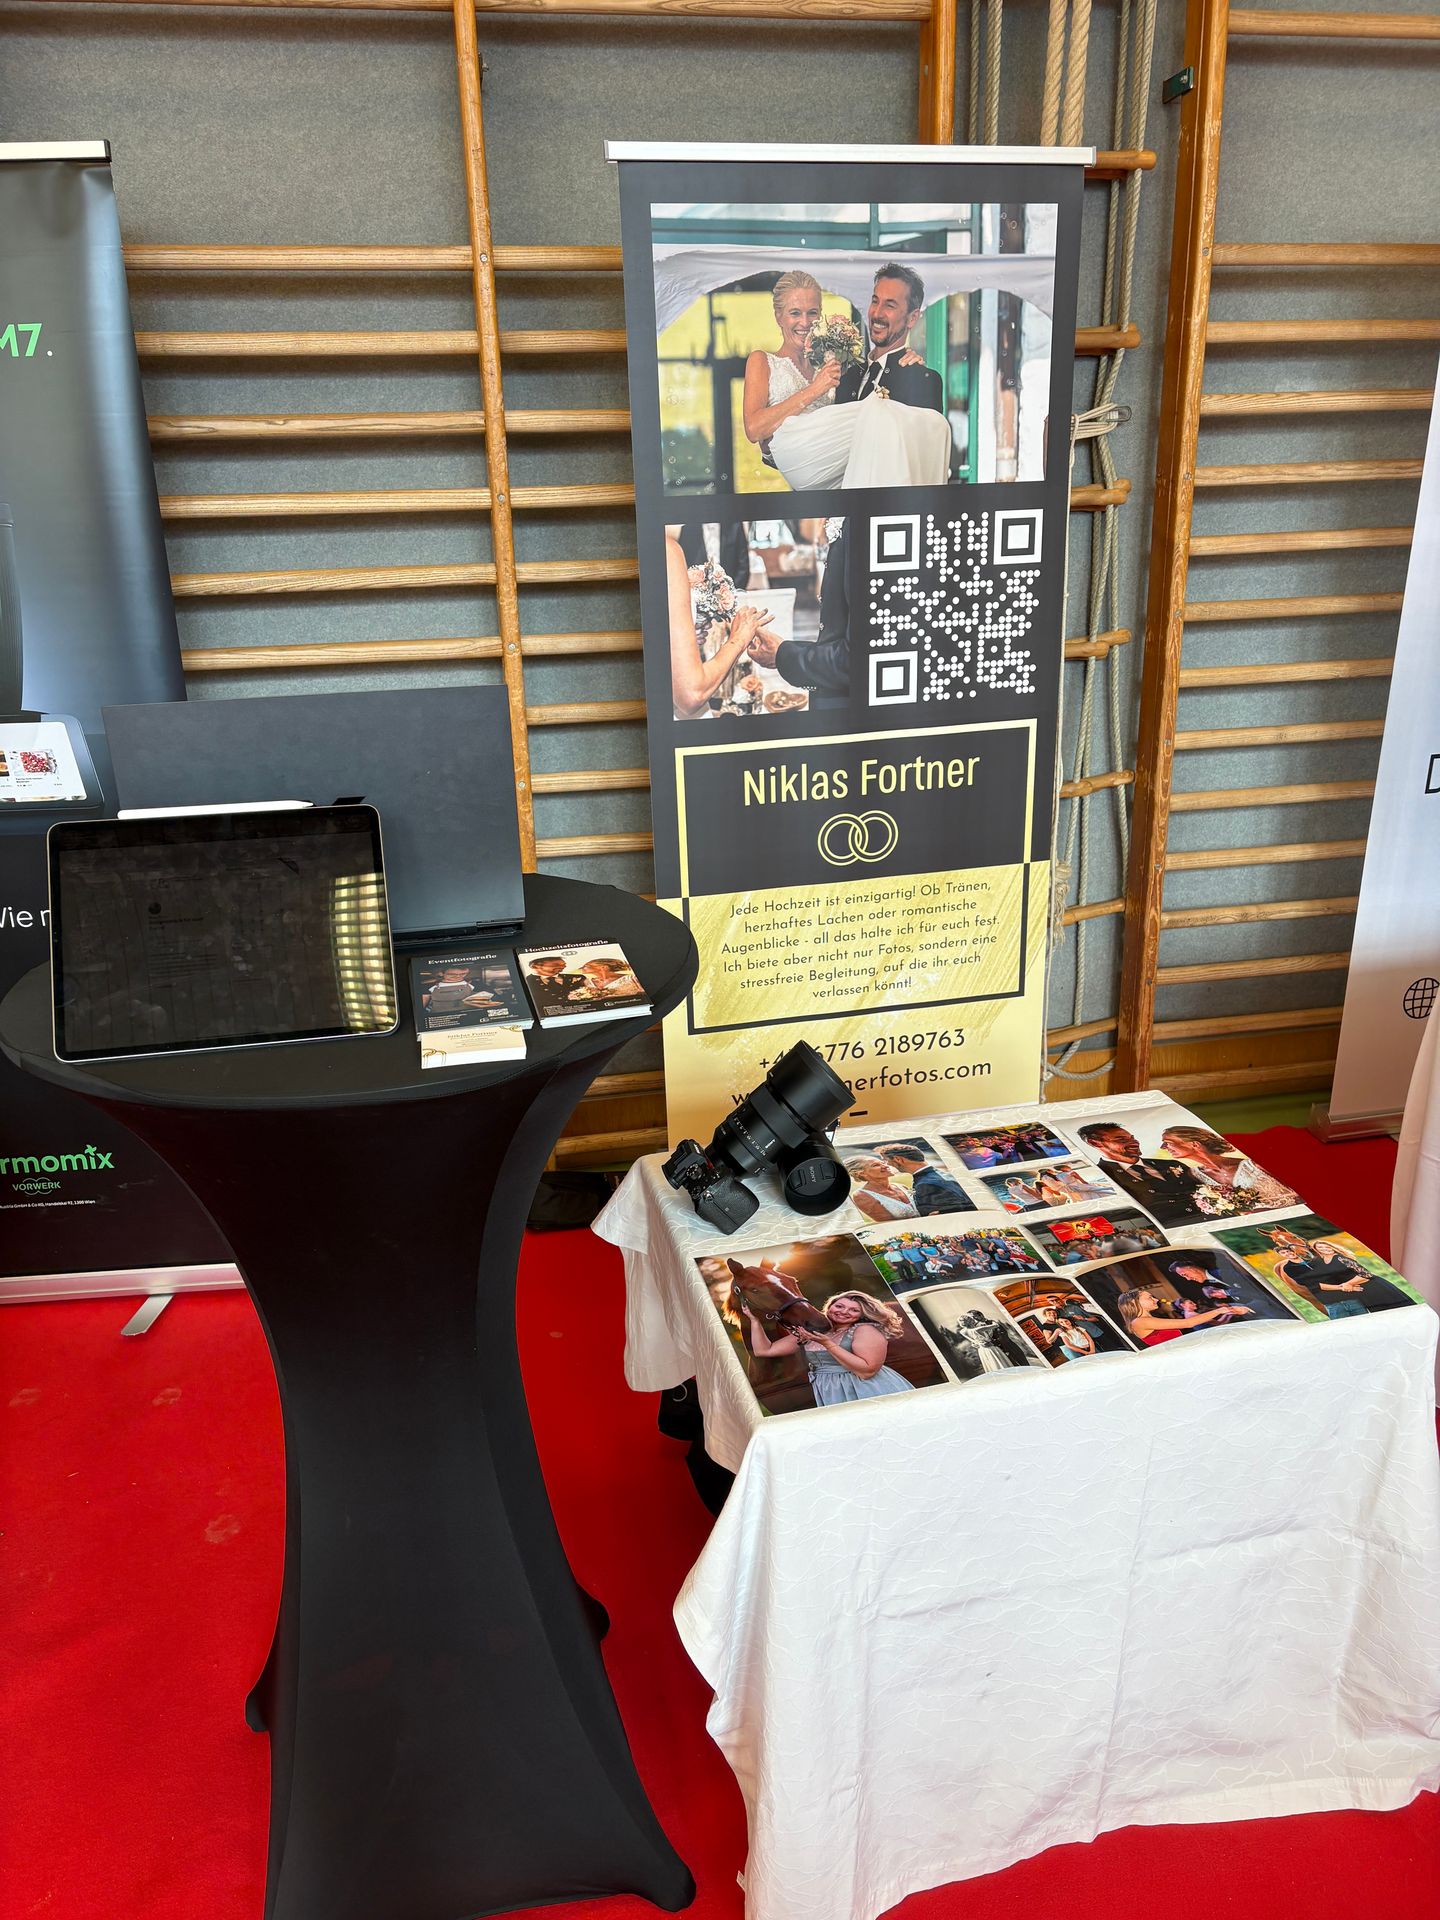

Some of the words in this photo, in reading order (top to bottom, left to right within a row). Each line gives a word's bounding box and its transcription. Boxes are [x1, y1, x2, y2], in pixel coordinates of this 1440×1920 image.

[743, 763, 848, 806] Niklas
[861, 755, 980, 796] Fortner
[730, 902, 759, 918] Jede
[765, 897, 821, 912] Hochzeit
[826, 895, 840, 906] ist
[845, 886, 916, 905] einzigartig!
[920, 883, 941, 896] Ob
[946, 881, 991, 894] Tränen,
[745, 916, 813, 933] herzhaftes
[818, 911, 864, 926] Lachen
[868, 907, 897, 920] oder
[901, 898, 977, 917] romantische
[0, 906, 33, 928] ie
[524, 939, 609, 953] Hochzeitsfotografie
[721, 935, 800, 955] Augenblicke
[813, 931, 829, 945] all
[834, 930, 856, 943] das
[861, 926, 892, 940] halte
[897, 922, 914, 935] ich
[920, 920, 938, 933] für
[941, 916, 970, 931] euch
[975, 915, 1000, 927] fest.
[428, 953, 497, 965] Eventfotografie
[723, 959, 742, 973] Ich
[747, 958, 779, 970] biete
[783, 953, 813, 966] aber
[818, 949, 848, 962] nicht
[853, 948, 874, 959] nur
[878, 943, 914, 956] Fotos,
[919, 937, 967, 951] sondern
[972, 934, 998, 945] eine
[740, 972, 804, 989] stressfreie
[809, 966, 879, 982] Begleitung,
[883, 959, 904, 973] auf
[908, 957, 928, 970] die
[932, 955, 949, 968] ihr
[953, 951, 981, 965] euch
[812, 984, 870, 998] verlassen
[873, 976, 912, 992] könnt!
[874, 1028, 965, 1057] 2189763
[12, 1181, 61, 1192] VORWERK
